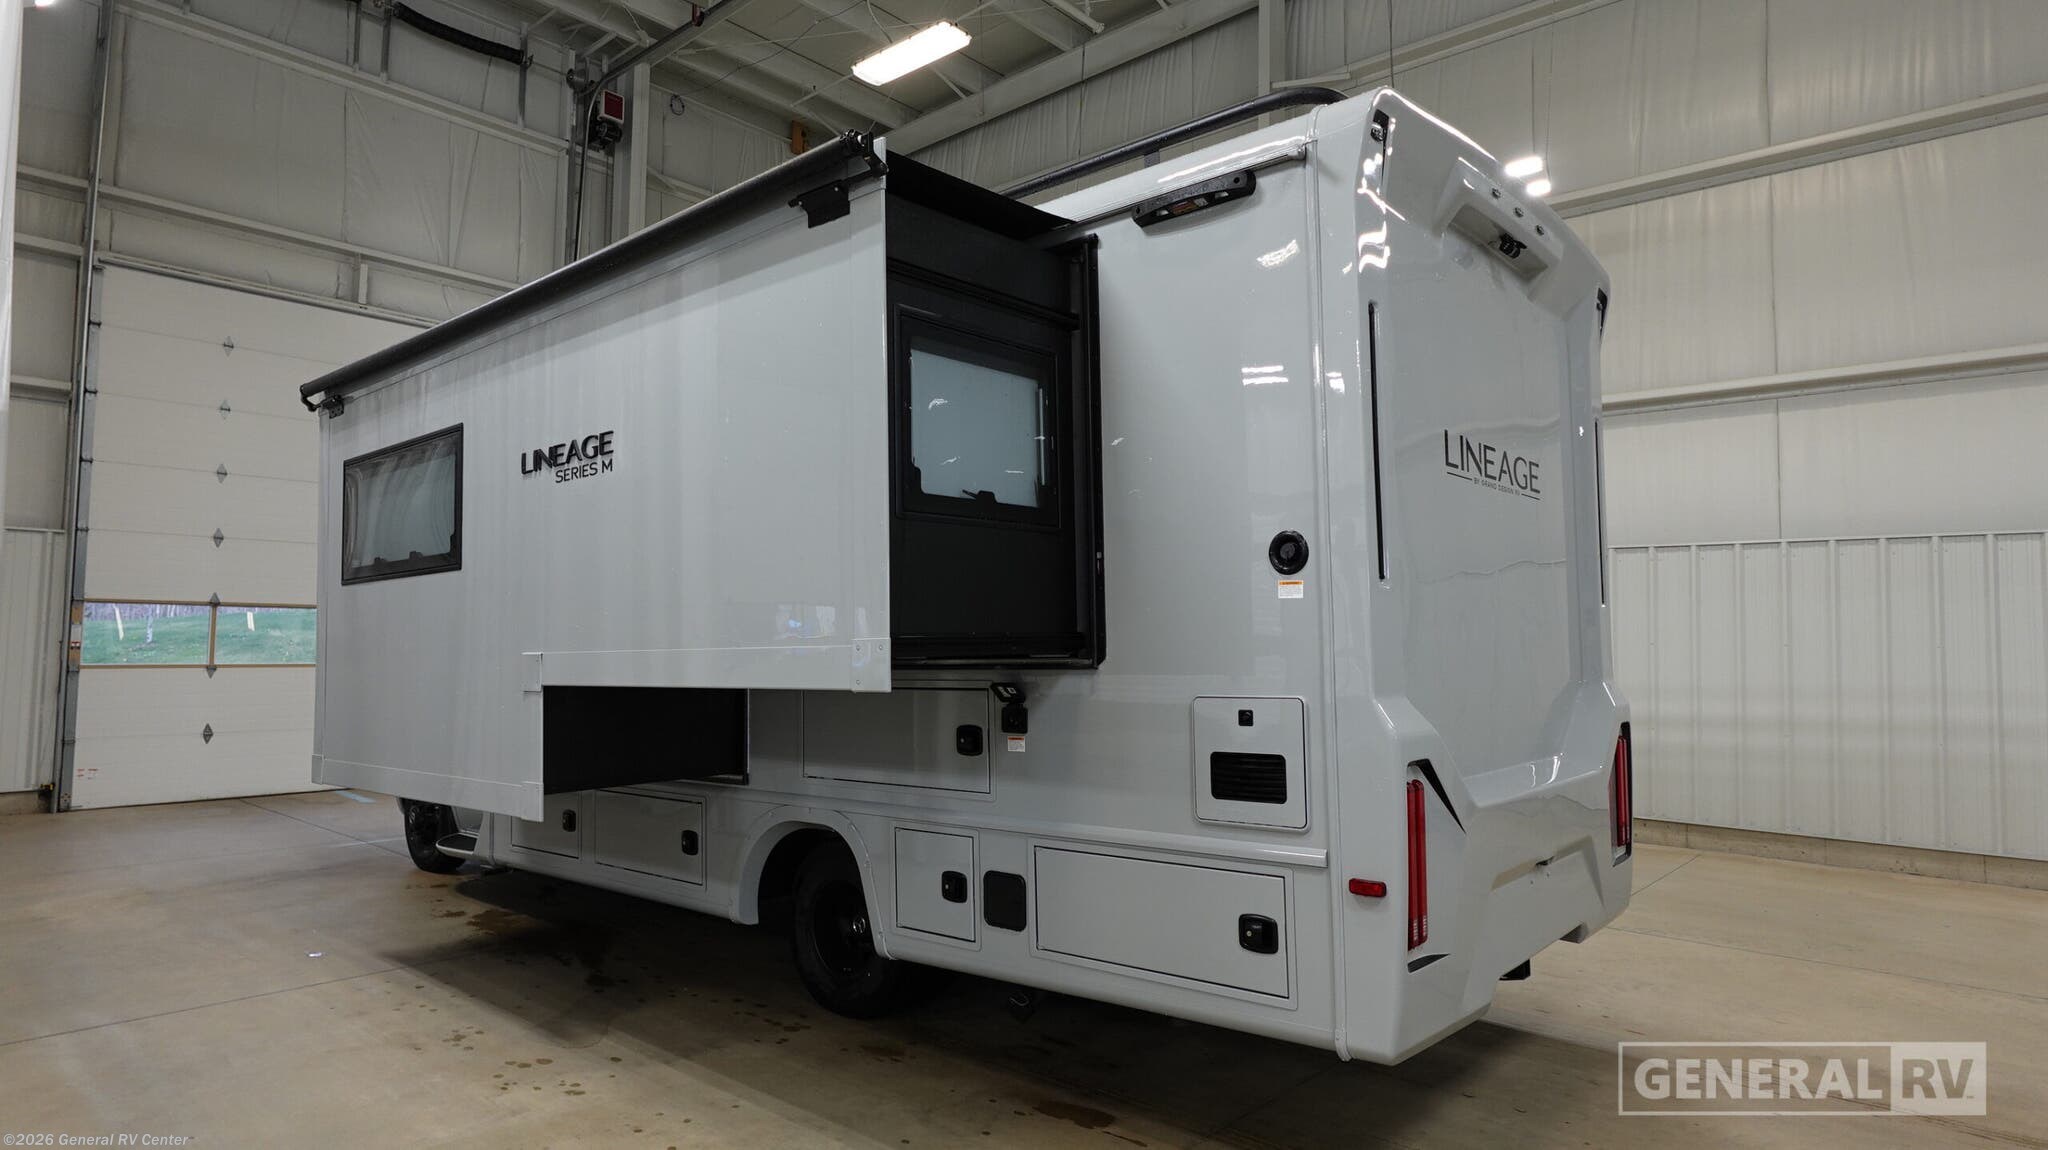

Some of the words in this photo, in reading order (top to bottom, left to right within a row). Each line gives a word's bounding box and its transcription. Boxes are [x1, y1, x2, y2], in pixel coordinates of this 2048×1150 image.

[521, 430, 614, 475] LINEAGE
[555, 461, 598, 484] SERIES
[601, 458, 613, 473] M
[1444, 429, 1541, 494] LINEAGE
